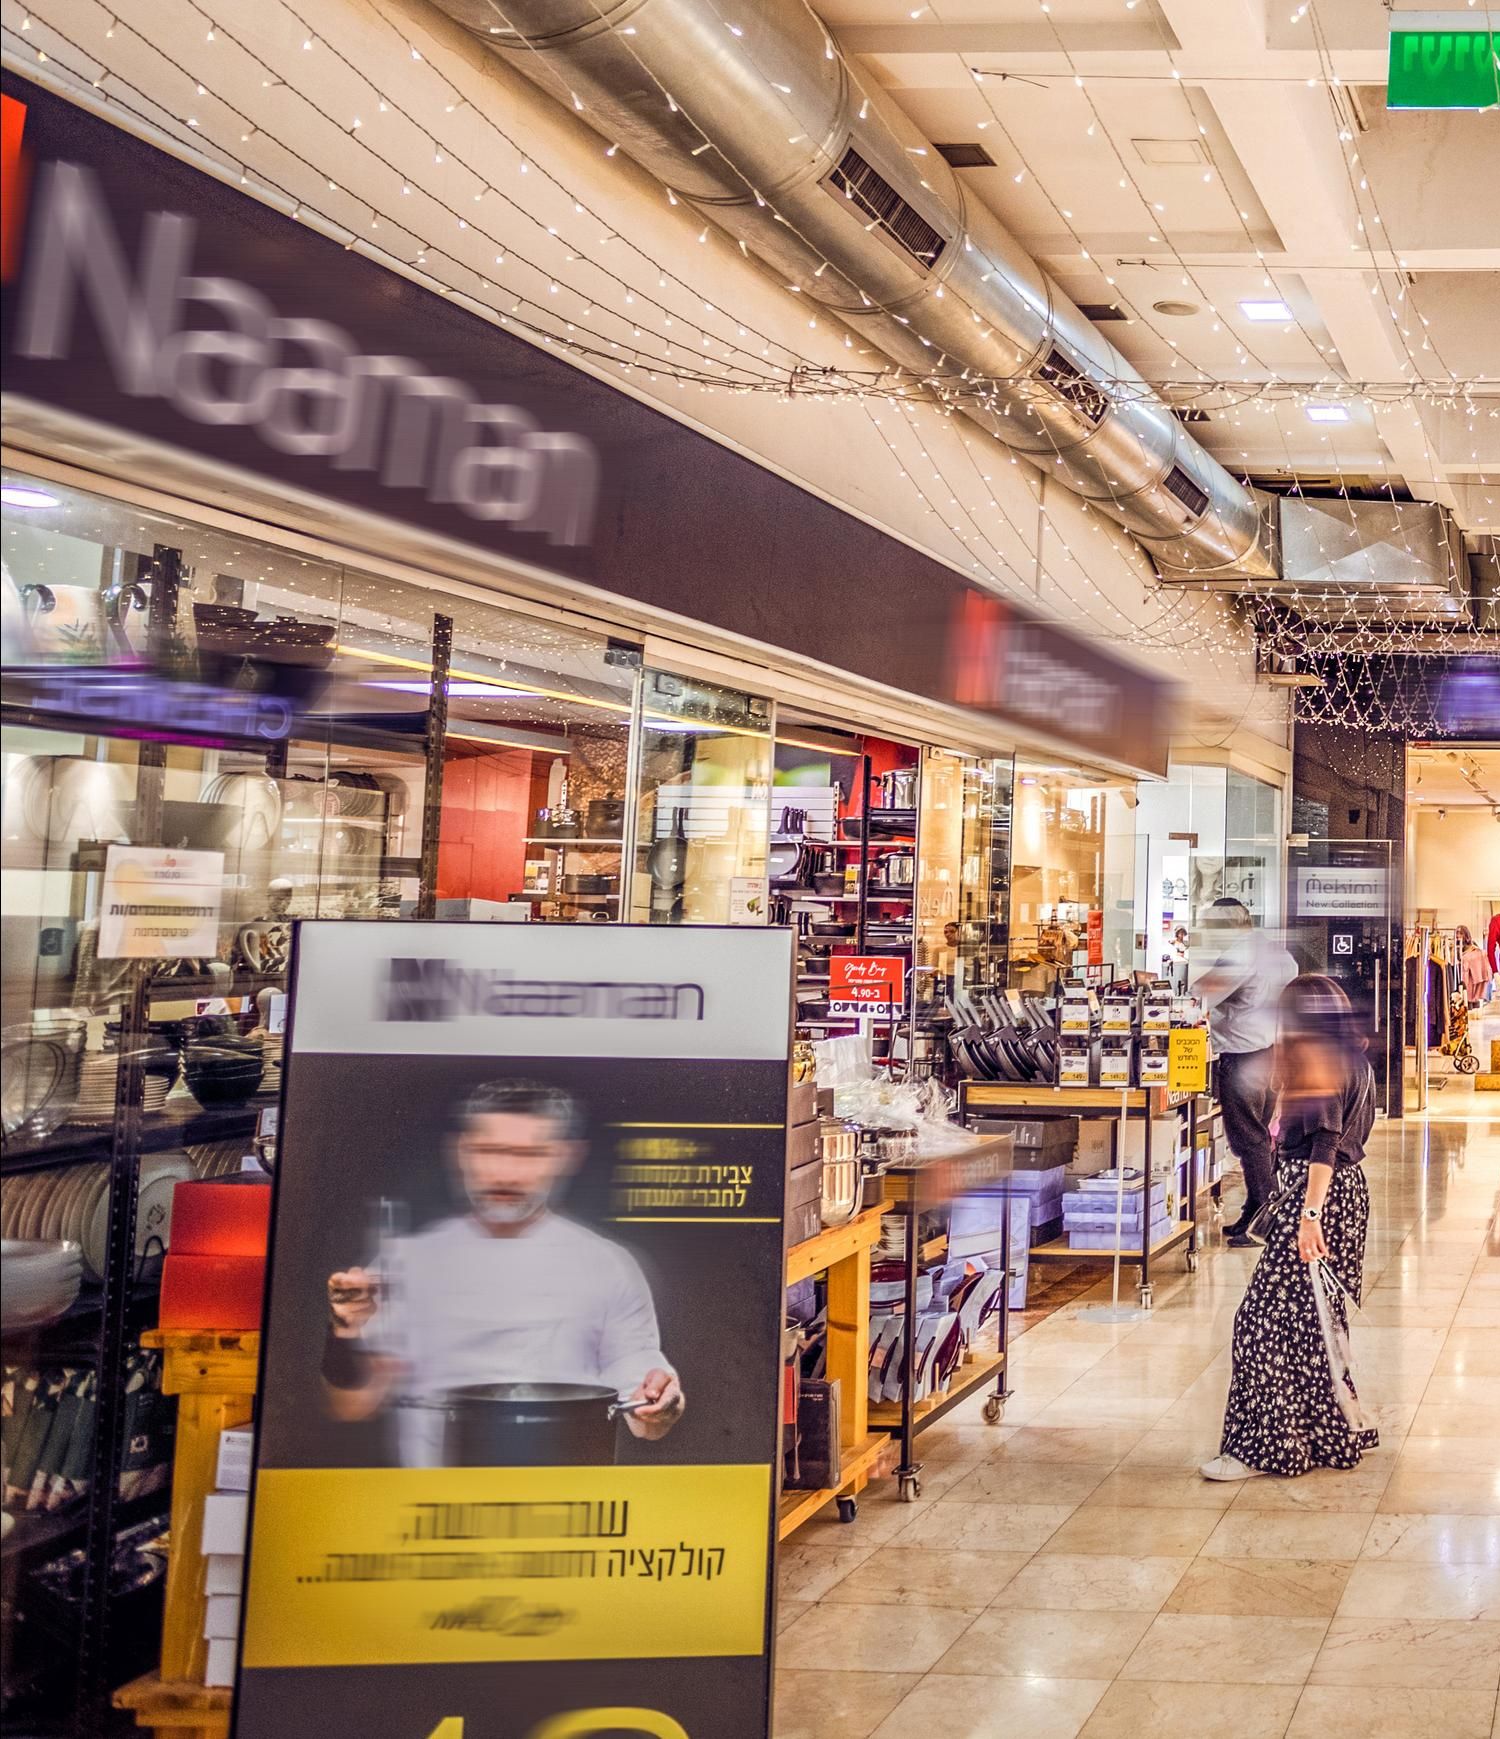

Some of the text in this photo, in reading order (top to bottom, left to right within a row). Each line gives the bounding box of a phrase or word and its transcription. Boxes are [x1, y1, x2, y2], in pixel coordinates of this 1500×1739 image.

[14, 160, 602, 547] Naaman
[1306, 900, 1328, 908] New
[696, 1165, 753, 1185] צבירת
[693, 1185, 747, 1208] לחברי
[606, 1542, 726, 1582] קולקציה
